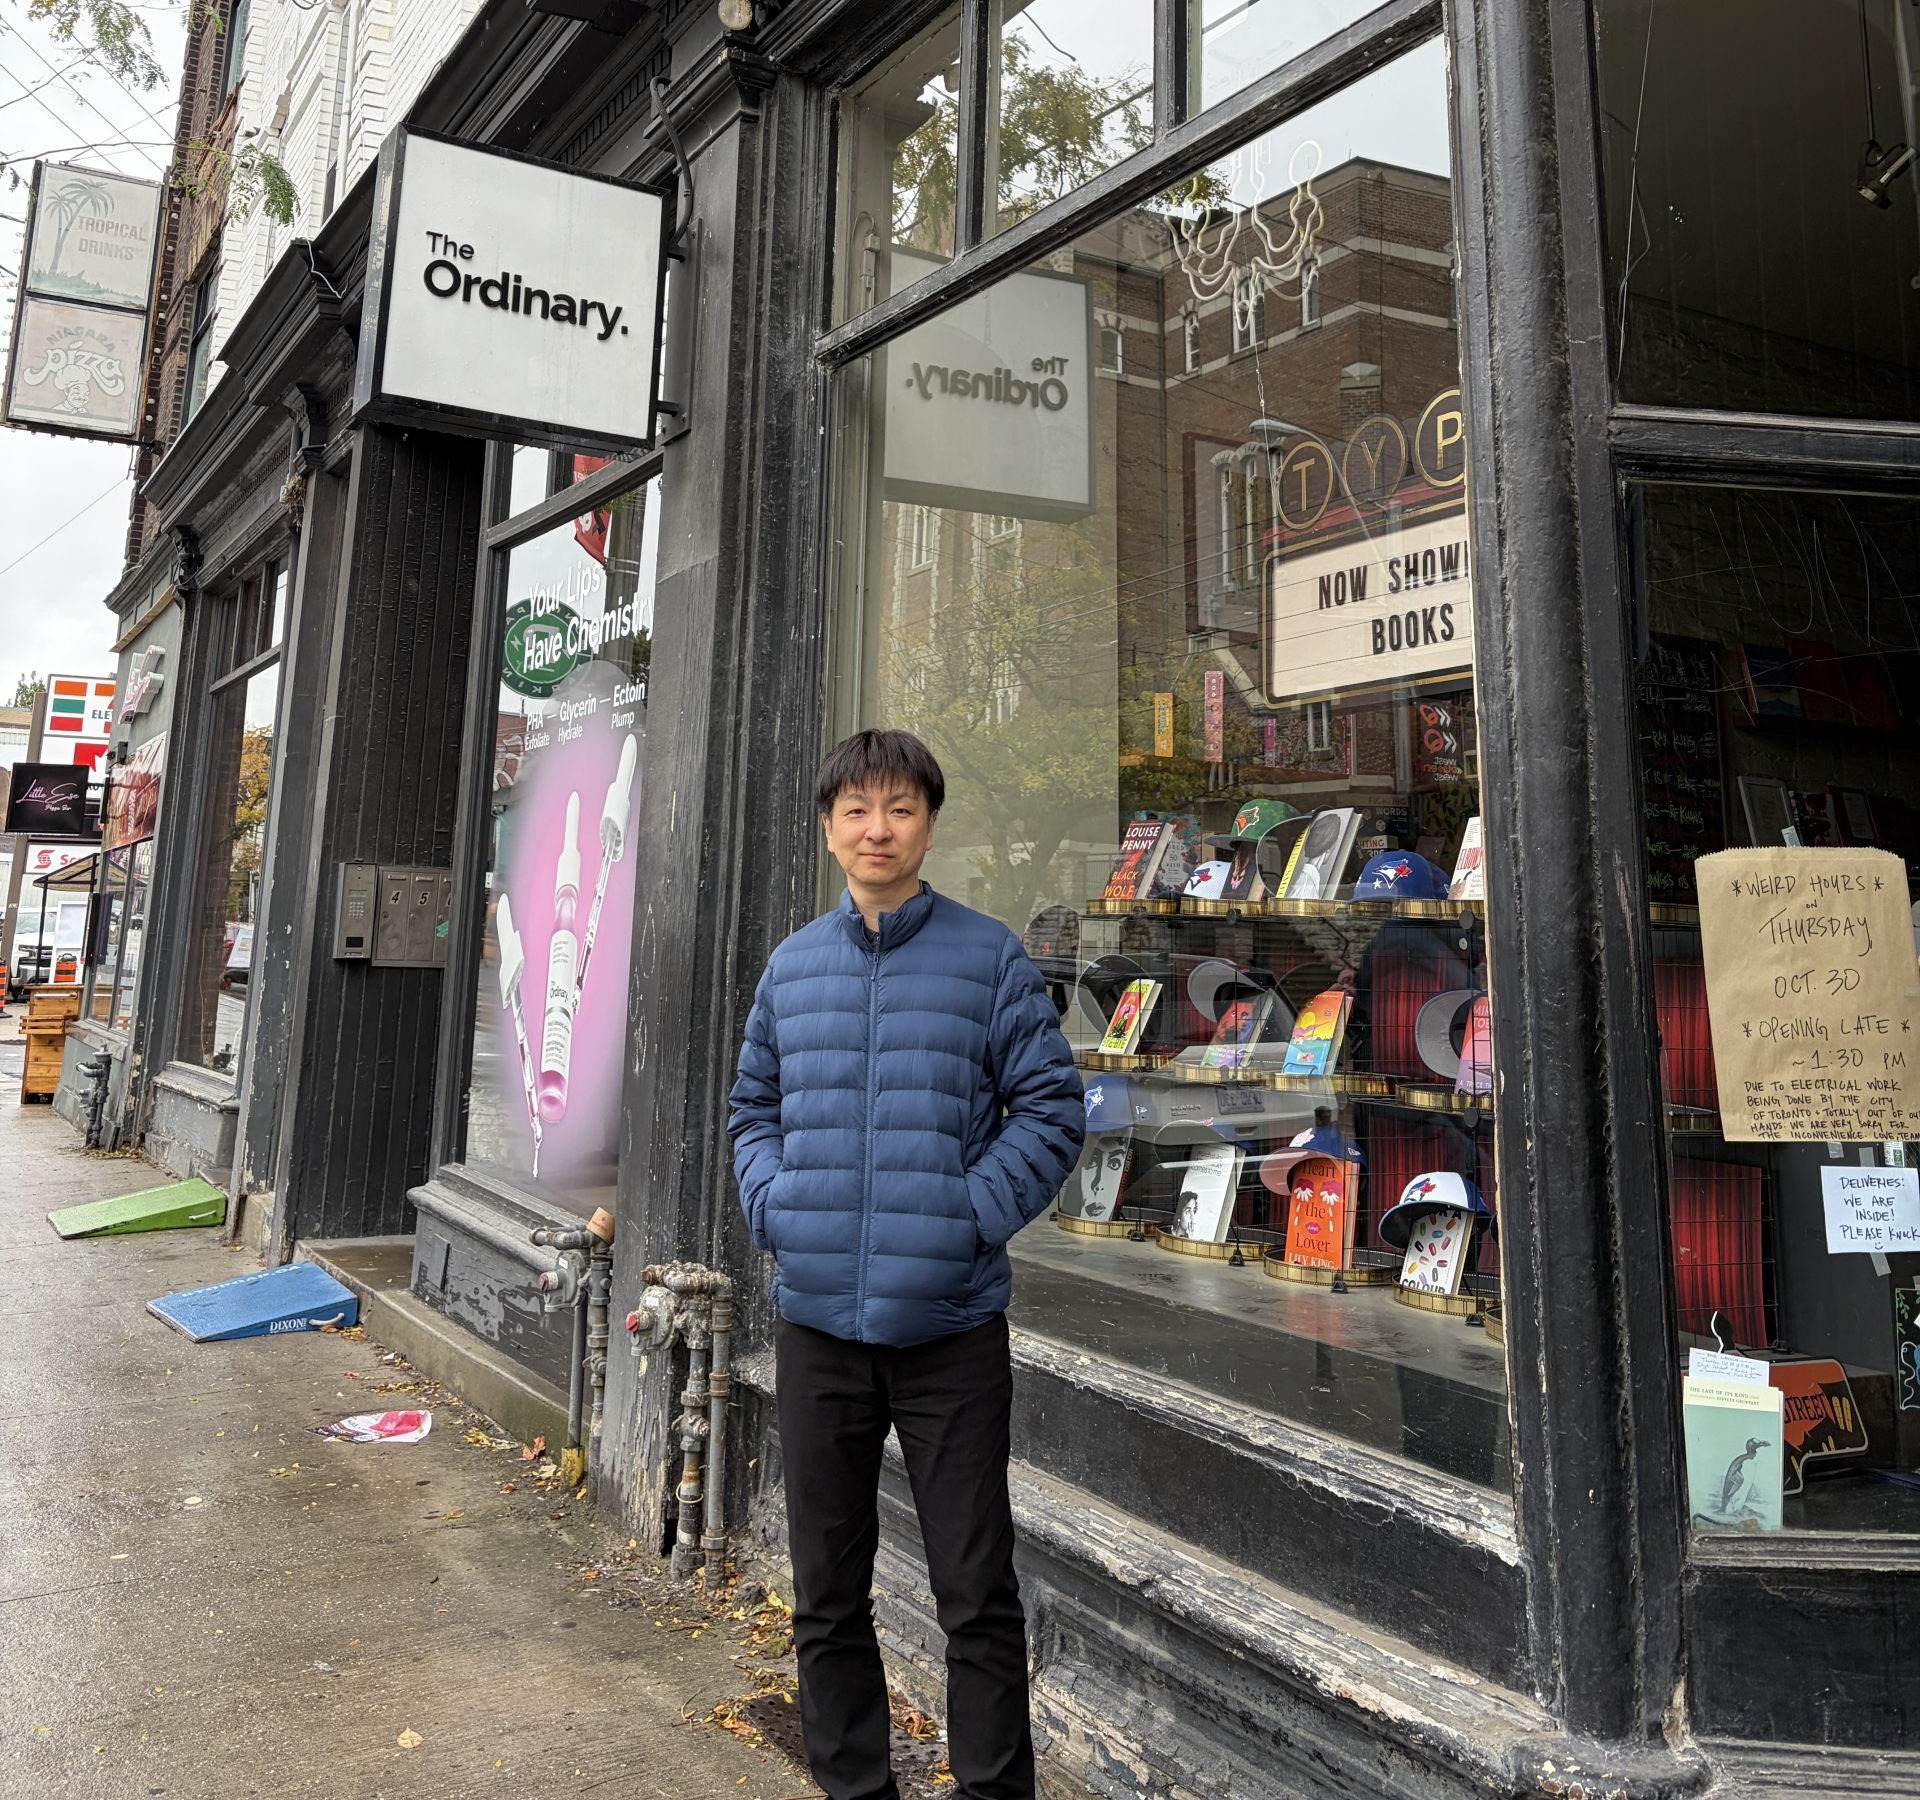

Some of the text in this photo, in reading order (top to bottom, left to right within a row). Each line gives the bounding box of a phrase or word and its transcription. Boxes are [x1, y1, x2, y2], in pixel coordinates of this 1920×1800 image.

[77, 215, 148, 242] TROPICAL
[78, 238, 135, 262] DRINKS
[426, 230, 475, 261] The
[423, 259, 629, 340] Ordinary.
[47, 325, 116, 354] NIAGARA
[529, 560, 601, 621] Your Lips
[1318, 564, 1368, 610] NOW
[523, 631, 562, 674] Have
[566, 591, 654, 656] Chemistry
[1372, 603, 1455, 655] BOOKS
[526, 678, 645, 732] PHA Glycerin Ectoin
[558, 724, 583, 747] Hydrate
[611, 711, 635, 730] Plump
[16, 779, 47, 804] Little
[1376, 807, 1408, 816] WORDS
[1126, 827, 1160, 838] LOUISE
[1121, 839, 1155, 851] PENNY
[1111, 871, 1139, 881] BLACK
[1746, 872, 1866, 897] WEIRD HOURS
[391, 891, 400, 904] 4
[419, 892, 429, 905] 5
[1103, 885, 1136, 898] WOLF
[1806, 900, 1818, 909] ON
[1759, 908, 1873, 957] THURSDAY
[1775, 969, 1860, 998] OCT. 30
[1759, 1015, 1890, 1043] OPENING LATE
[1883, 1051, 1906, 1070] PM
[1466, 1080, 1484, 1089] TRCE
[1744, 1078, 1902, 1093] DUE TO ELECTRICAL WORK
[1747, 1094, 1895, 1111] BEING DONE BY THE CITY
[1753, 1110, 1767, 1121] OF
[1770, 1108, 1812, 1121] TORONTO
[1823, 1107, 1861, 1123] TOTALLY
[1867, 1108, 1887, 1118] OUT
[1893, 1109, 1904, 1119] OF
[1909, 1110, 1920, 1121] OU
[1791, 1121, 1805, 1130] WE
[1810, 1119, 1828, 1129] ARE
[1831, 1119, 1853, 1134] VERY
[1858, 1119, 1884, 1131] SORRY
[1889, 1120, 1910, 1130] FOR
[1758, 1132, 1782, 1141] THE
[1791, 1130, 1868, 1141] INCONVENIENCE.
[1303, 1160, 1336, 1179] Heart
[1840, 1174, 1905, 1190] DELIVERIES:
[1843, 1194, 1895, 1207] WE ARE
[1305, 1202, 1326, 1219] the
[1856, 1208, 1895, 1222] INSIDE!
[1840, 1224, 1883, 1240] PLEASE
[1296, 1233, 1331, 1253] Lover
[1288, 1252, 1335, 1269] LILY KING
[269, 1317, 304, 1332] DIXON
